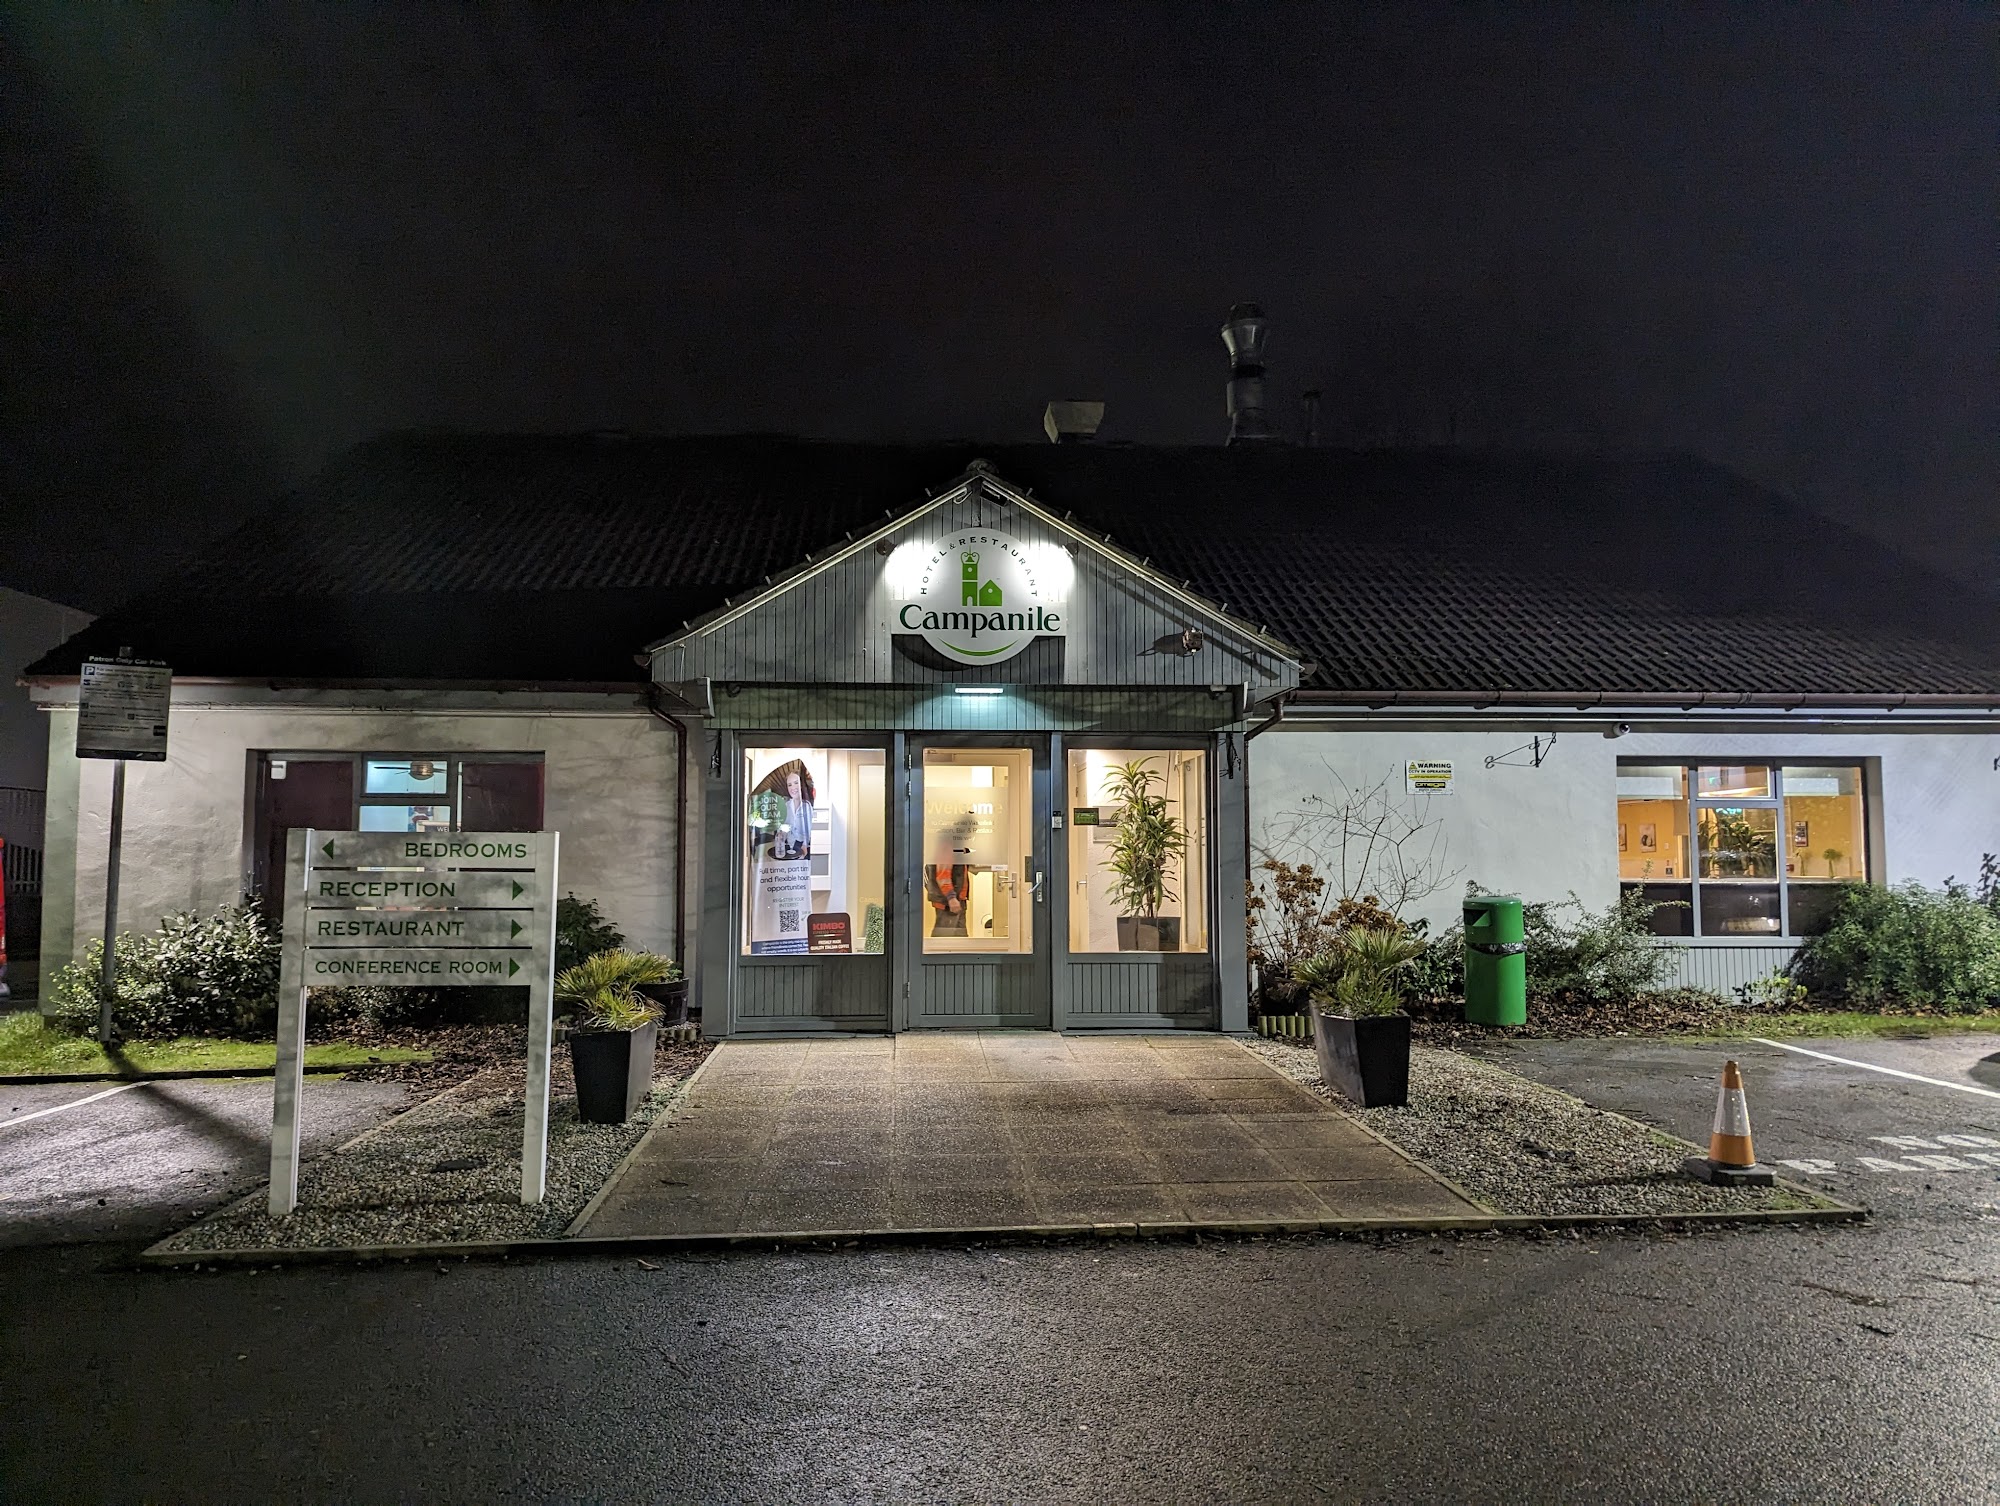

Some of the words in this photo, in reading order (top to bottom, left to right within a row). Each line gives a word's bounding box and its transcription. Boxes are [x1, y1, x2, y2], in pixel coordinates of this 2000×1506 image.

[920, 550, 947, 595] HOTEL
[958, 536, 1038, 597] RESTAURANT
[899, 604, 1061, 638] Campanile
[760, 796, 778, 804] JOIN
[761, 803, 778, 811] OUR
[761, 811, 781, 819] TEAM
[405, 842, 527, 859] BEDROOMS
[319, 881, 456, 897] RECEPTION
[767, 884, 807, 893] opportunities
[318, 921, 465, 936] RESTAURANT
[812, 922, 846, 930] KIMBO
[315, 960, 442, 975] CONFERENCE
[450, 960, 503, 975] ROOM
[1866, 1133, 2000, 1151] NO
